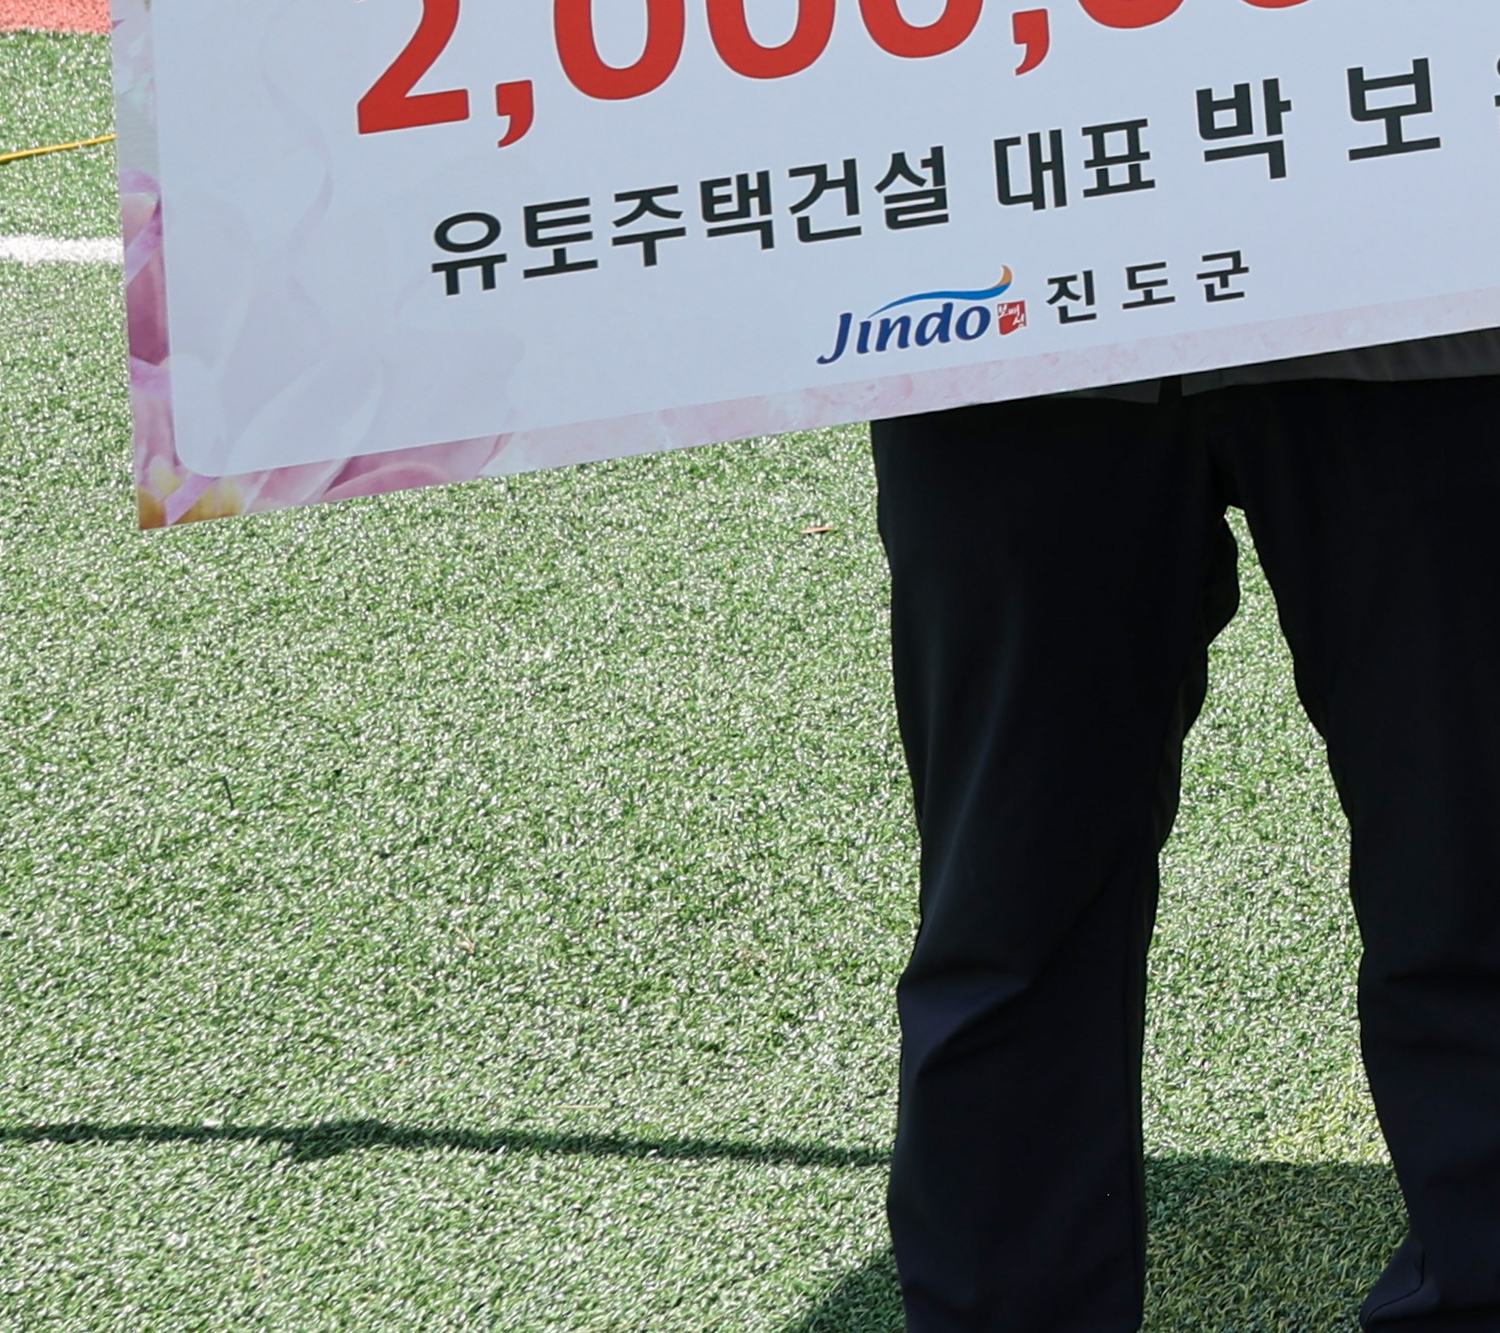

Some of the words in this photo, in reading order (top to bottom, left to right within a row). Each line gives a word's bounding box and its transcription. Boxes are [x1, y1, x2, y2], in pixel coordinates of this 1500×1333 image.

[432, 146, 949, 295] 유토주택건설
[994, 119, 1155, 210] 대표
[818, 302, 990, 363] Jindo
